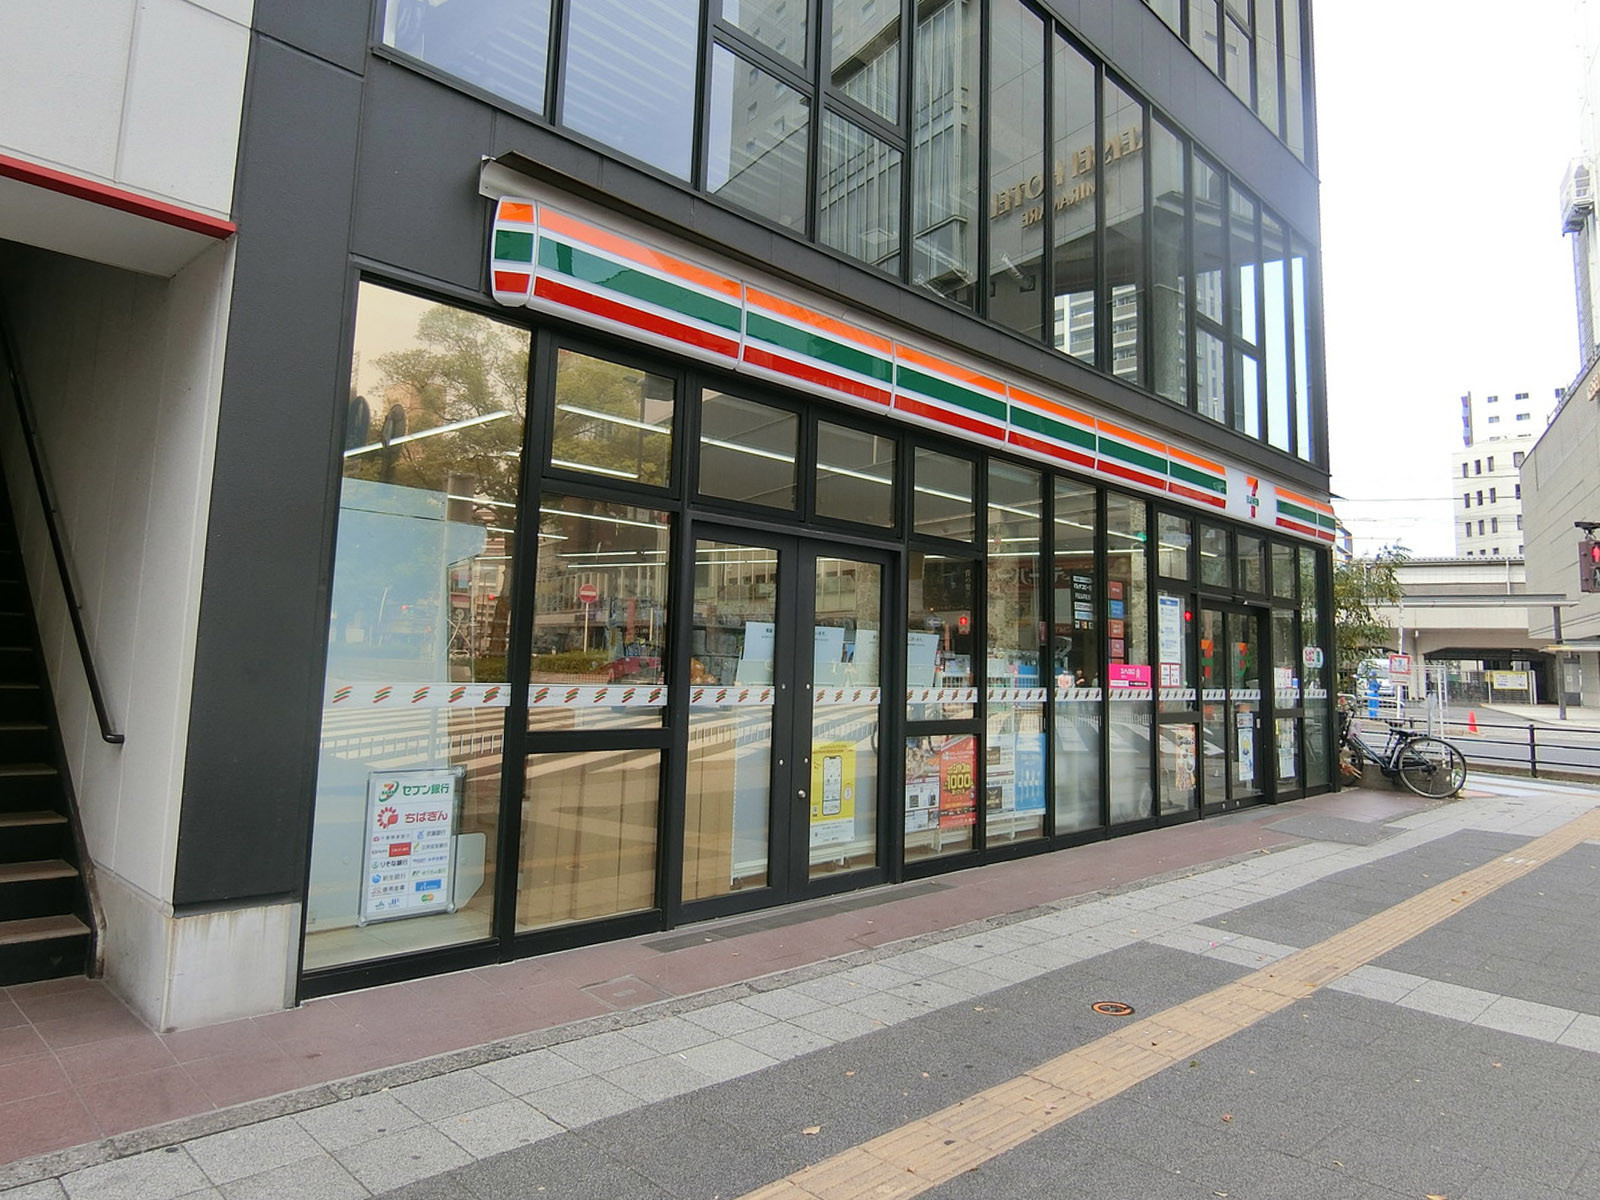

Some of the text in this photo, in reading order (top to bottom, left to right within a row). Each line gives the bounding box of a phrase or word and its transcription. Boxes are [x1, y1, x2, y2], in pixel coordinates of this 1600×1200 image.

[402, 783, 449, 796] セブン銀行
[405, 810, 448, 824] ちばぎん
[380, 859, 408, 868] りそな銀行
